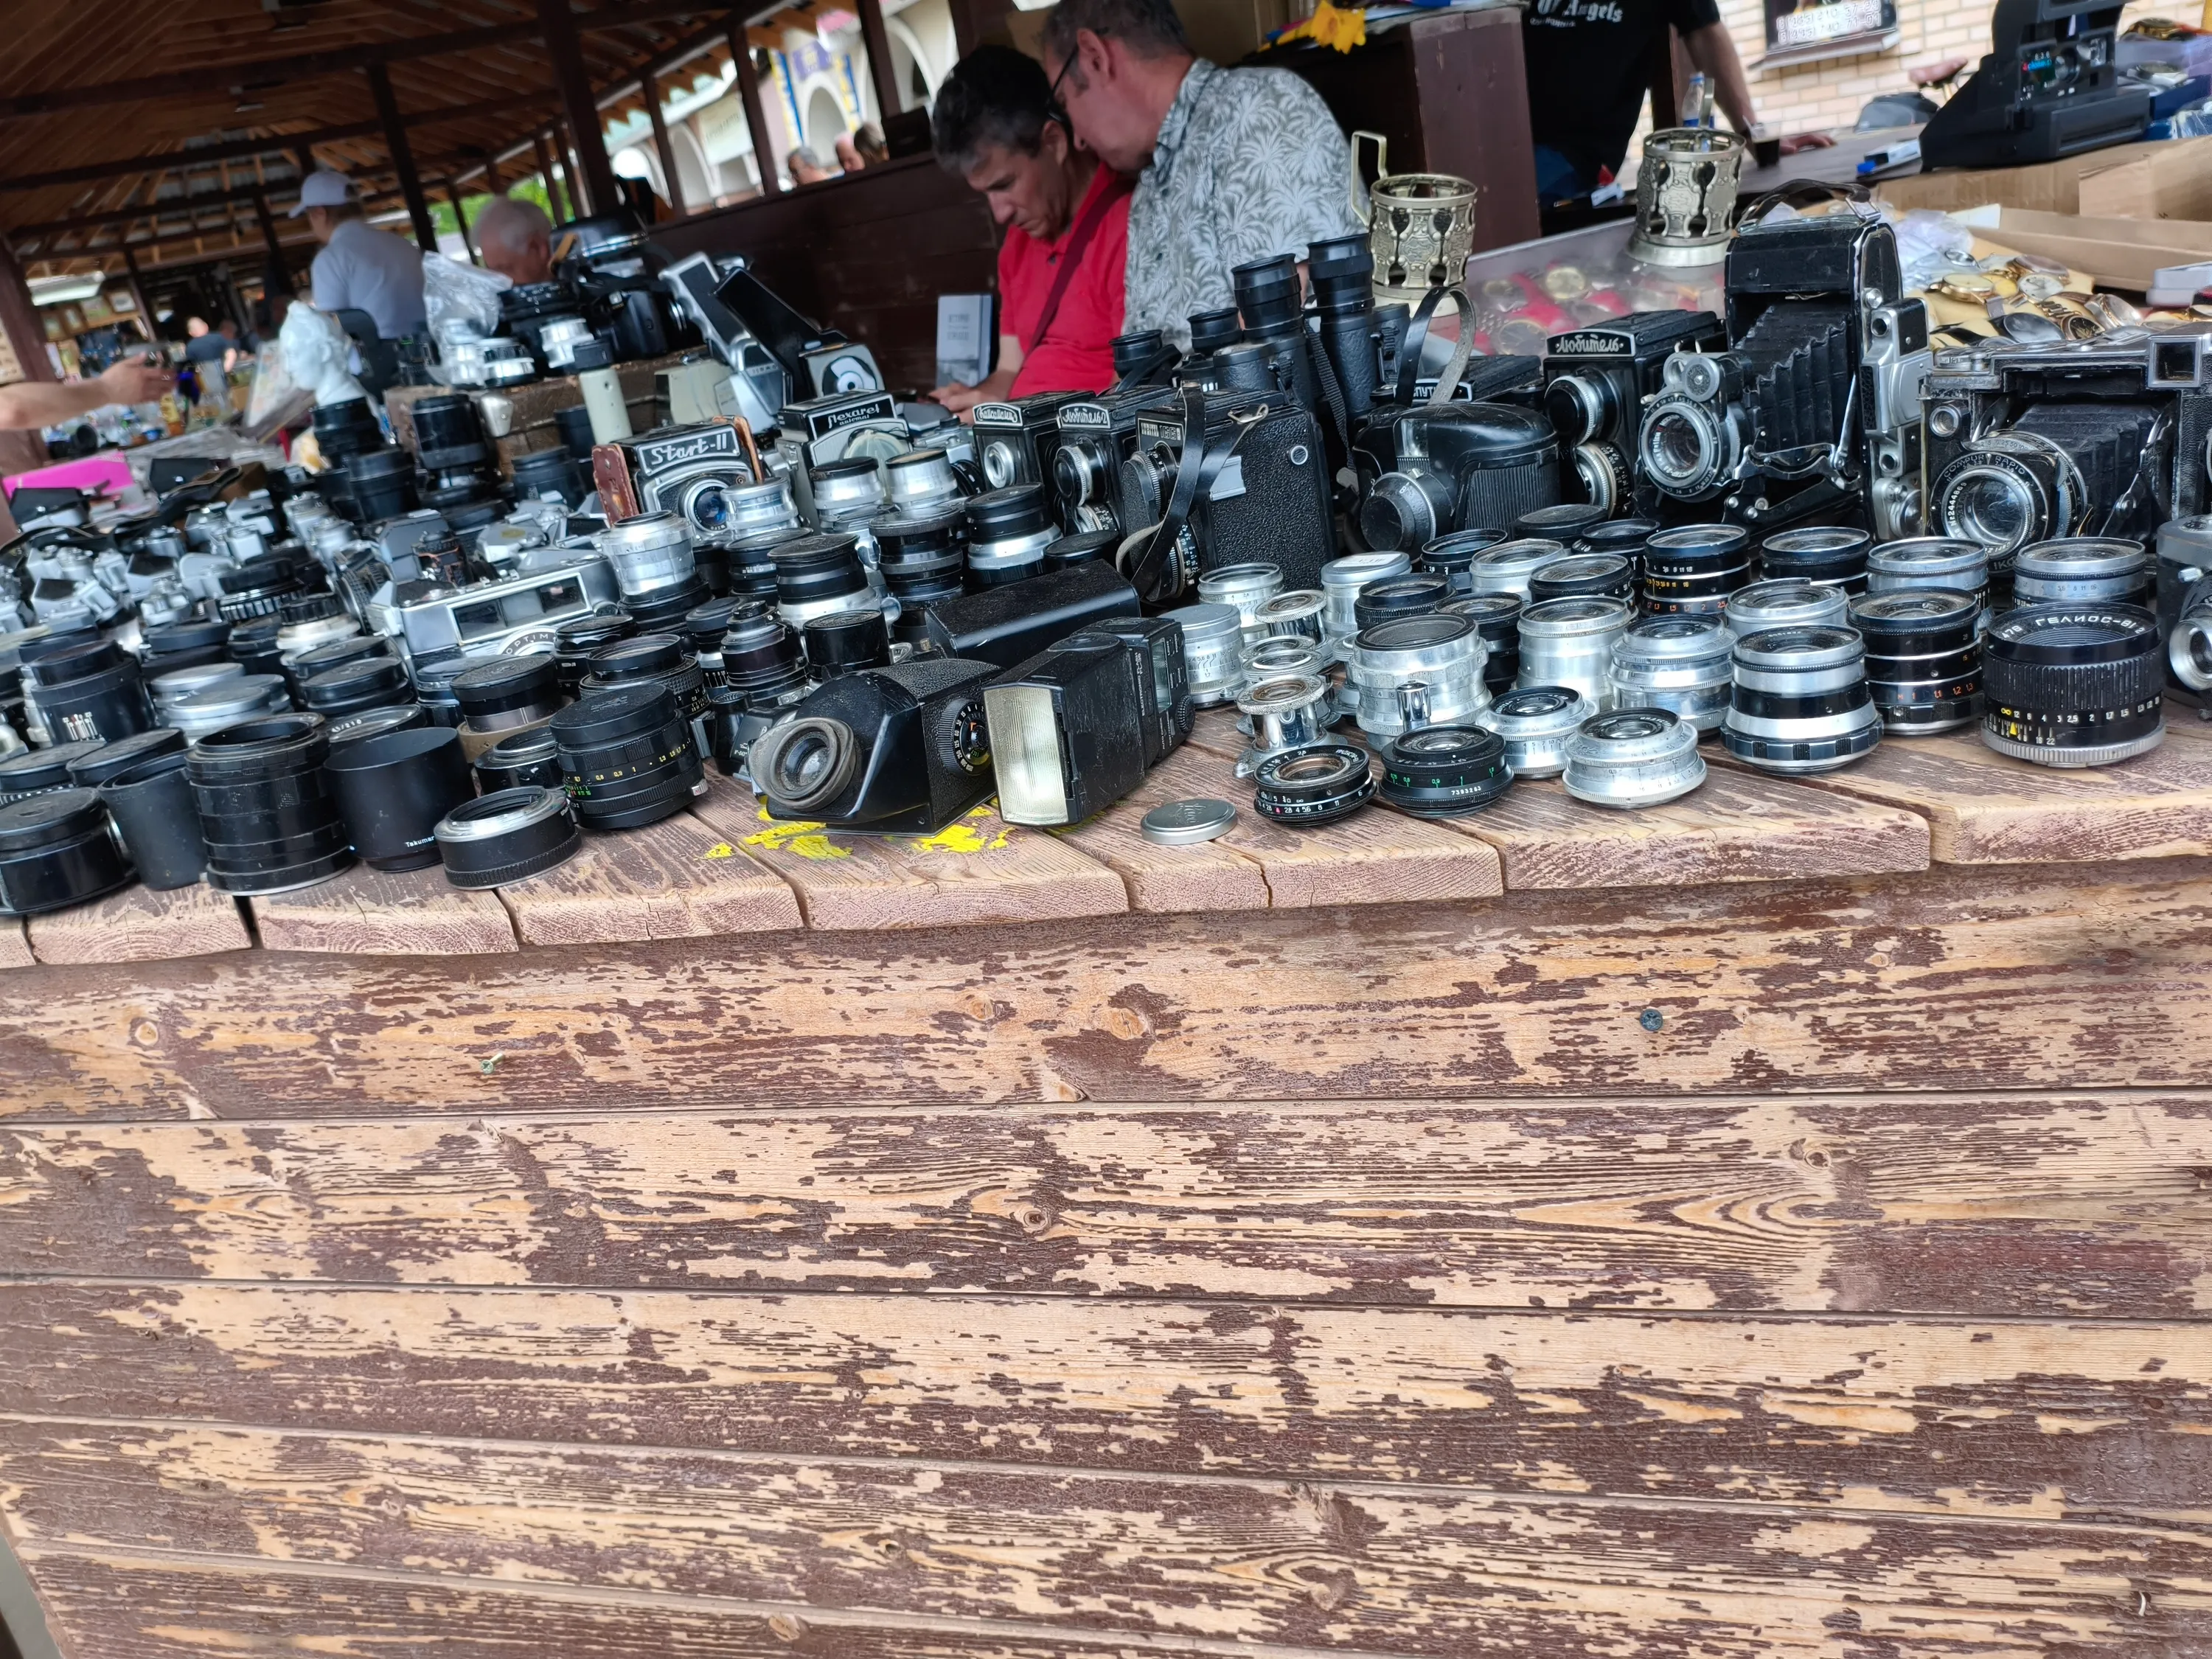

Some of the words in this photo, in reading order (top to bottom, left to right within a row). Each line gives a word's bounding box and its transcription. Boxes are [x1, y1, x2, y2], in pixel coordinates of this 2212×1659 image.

[1556, 333, 1620, 353] Любитель
[827, 403, 880, 429] flexaret
[839, 414, 870, 425] automat
[651, 433, 727, 465] Start-II
[1944, 454, 1984, 478] COMPUR
[1994, 455, 2025, 475] RAPID
[2089, 714, 2095, 722] 2
[405, 835, 435, 847] Takumar
